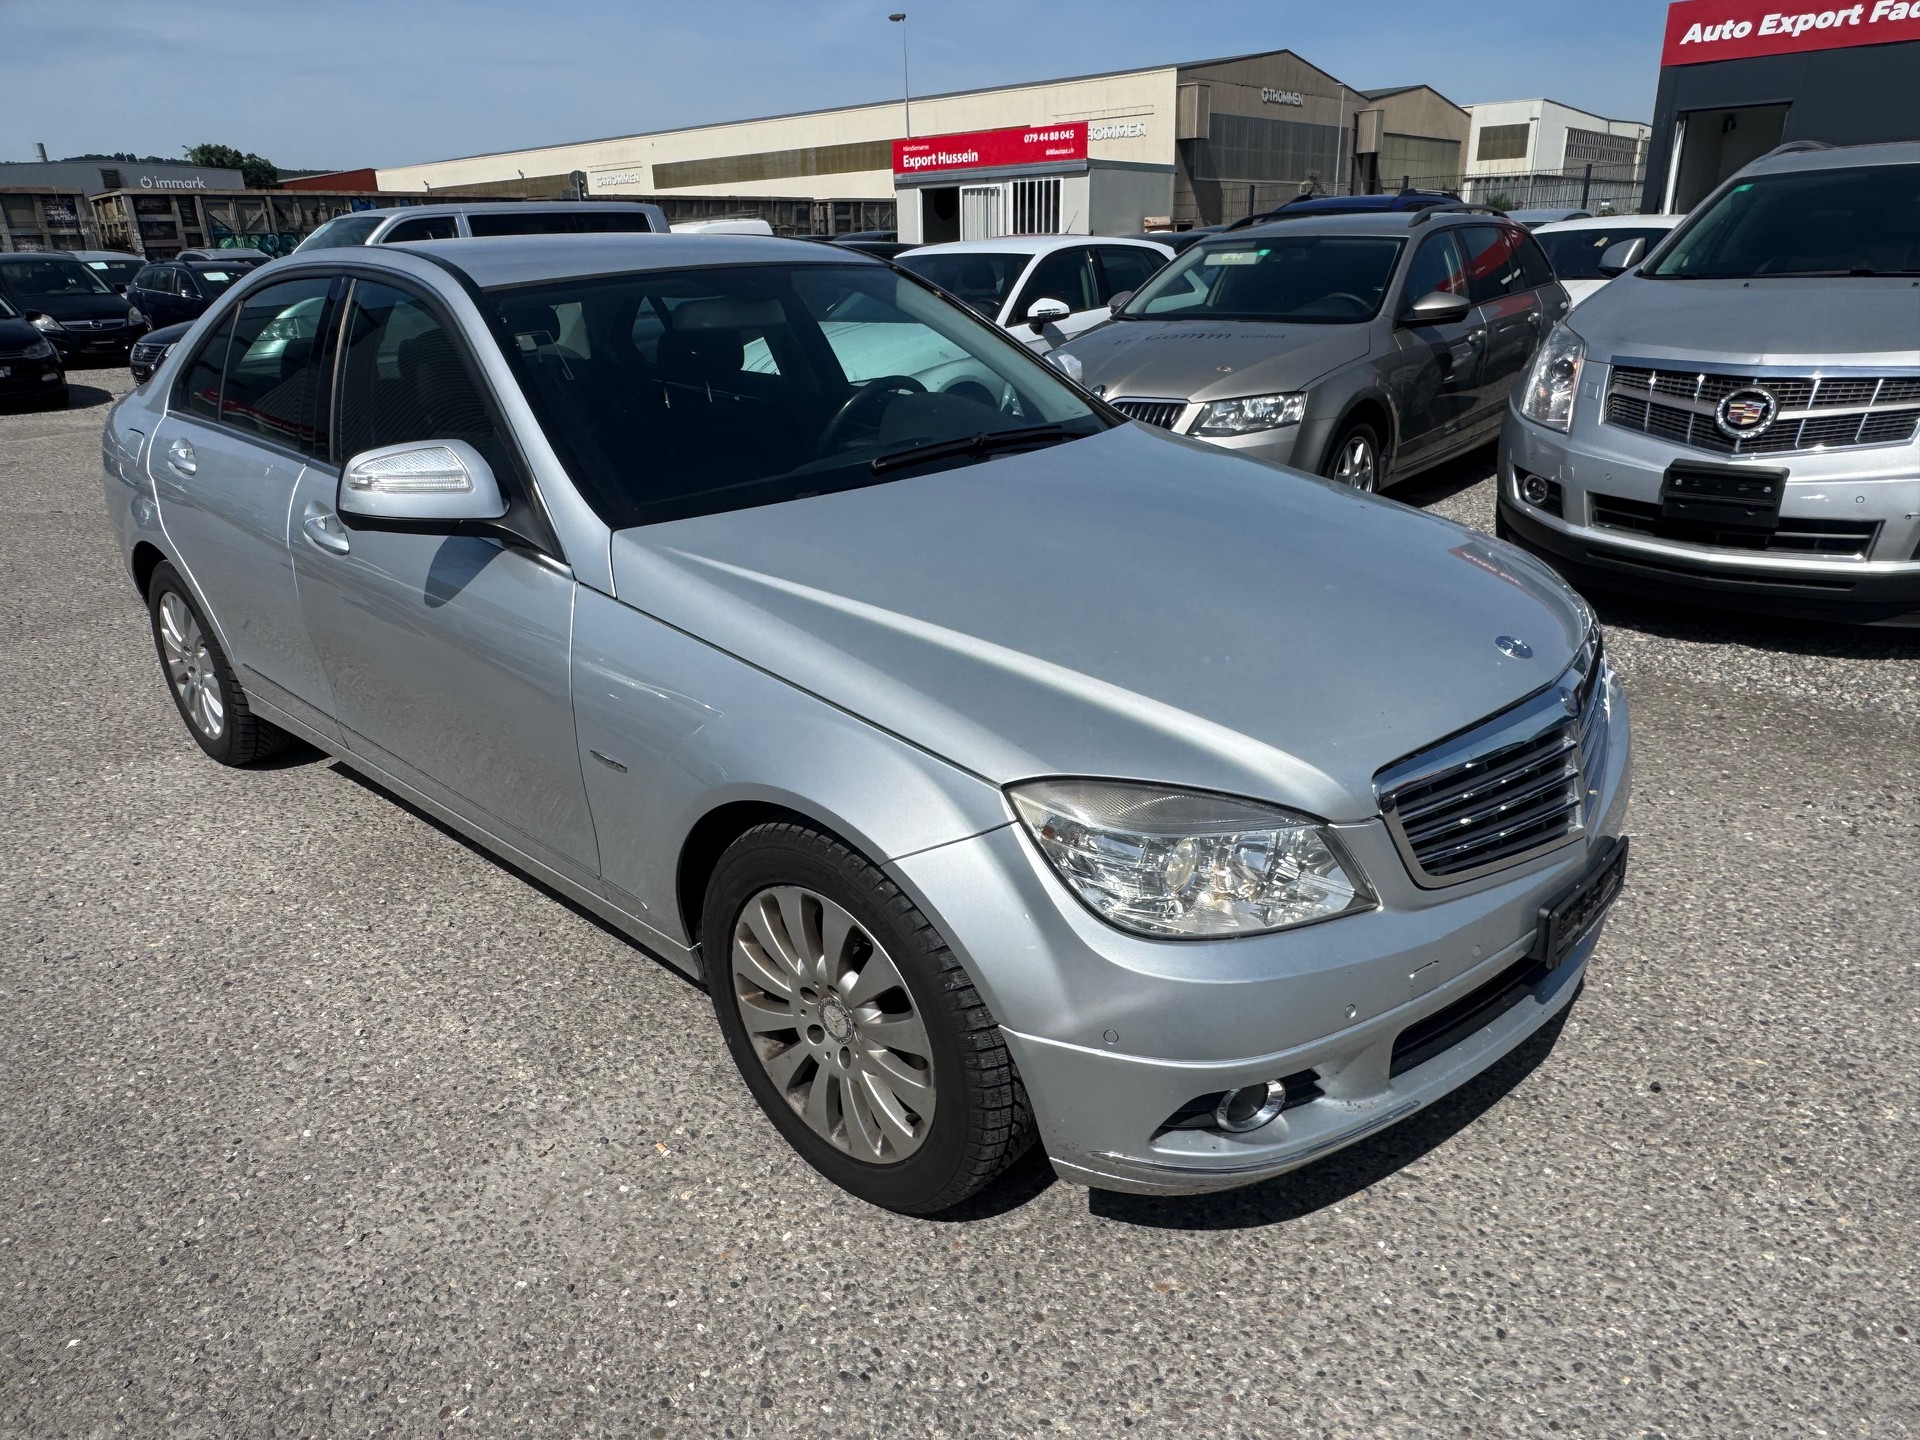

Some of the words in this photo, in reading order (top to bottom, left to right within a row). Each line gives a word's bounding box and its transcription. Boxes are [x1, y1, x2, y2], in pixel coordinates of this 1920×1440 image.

[1679, 19, 1753, 45] Auto
[1757, 4, 1864, 37] Export
[1024, 133, 1038, 143] 079
[1039, 132, 1049, 142] 44
[1049, 131, 1059, 141] 88
[1060, 130, 1075, 140] 045
[903, 152, 936, 169] Export
[938, 149, 979, 165] Hussein
[154, 176, 206, 189] immark
